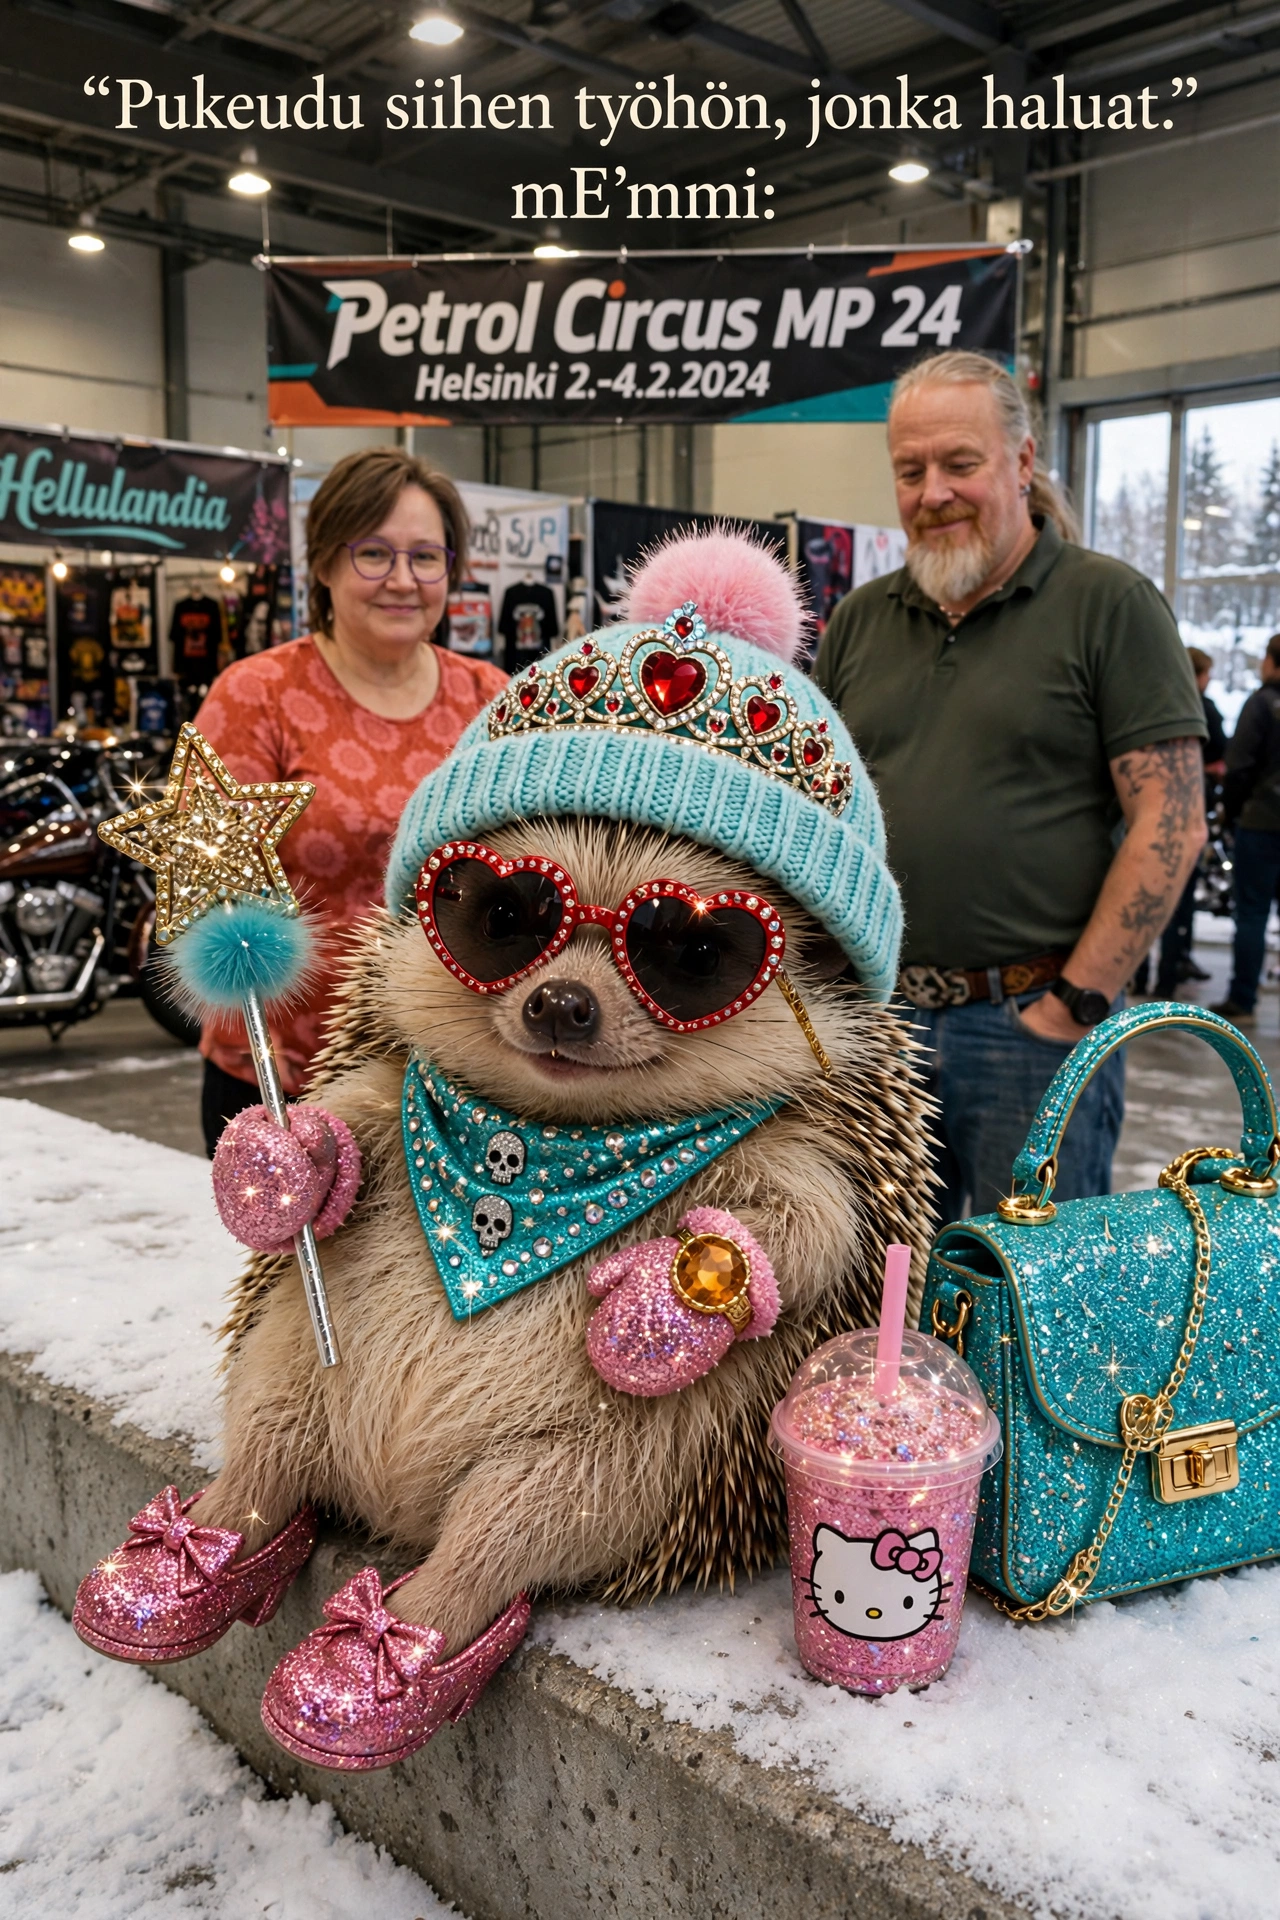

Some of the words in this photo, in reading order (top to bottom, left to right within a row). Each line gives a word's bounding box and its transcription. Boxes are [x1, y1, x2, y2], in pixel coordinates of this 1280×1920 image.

[323, 279, 544, 370] Petrol
[554, 278, 762, 354] Circus
[772, 287, 876, 350] MP
[880, 284, 963, 347] 24
[415, 361, 559, 401] Helsinki
[564, 361, 771, 400] 2.-4.2.2024
[0, 447, 231, 531] Hellulandia
